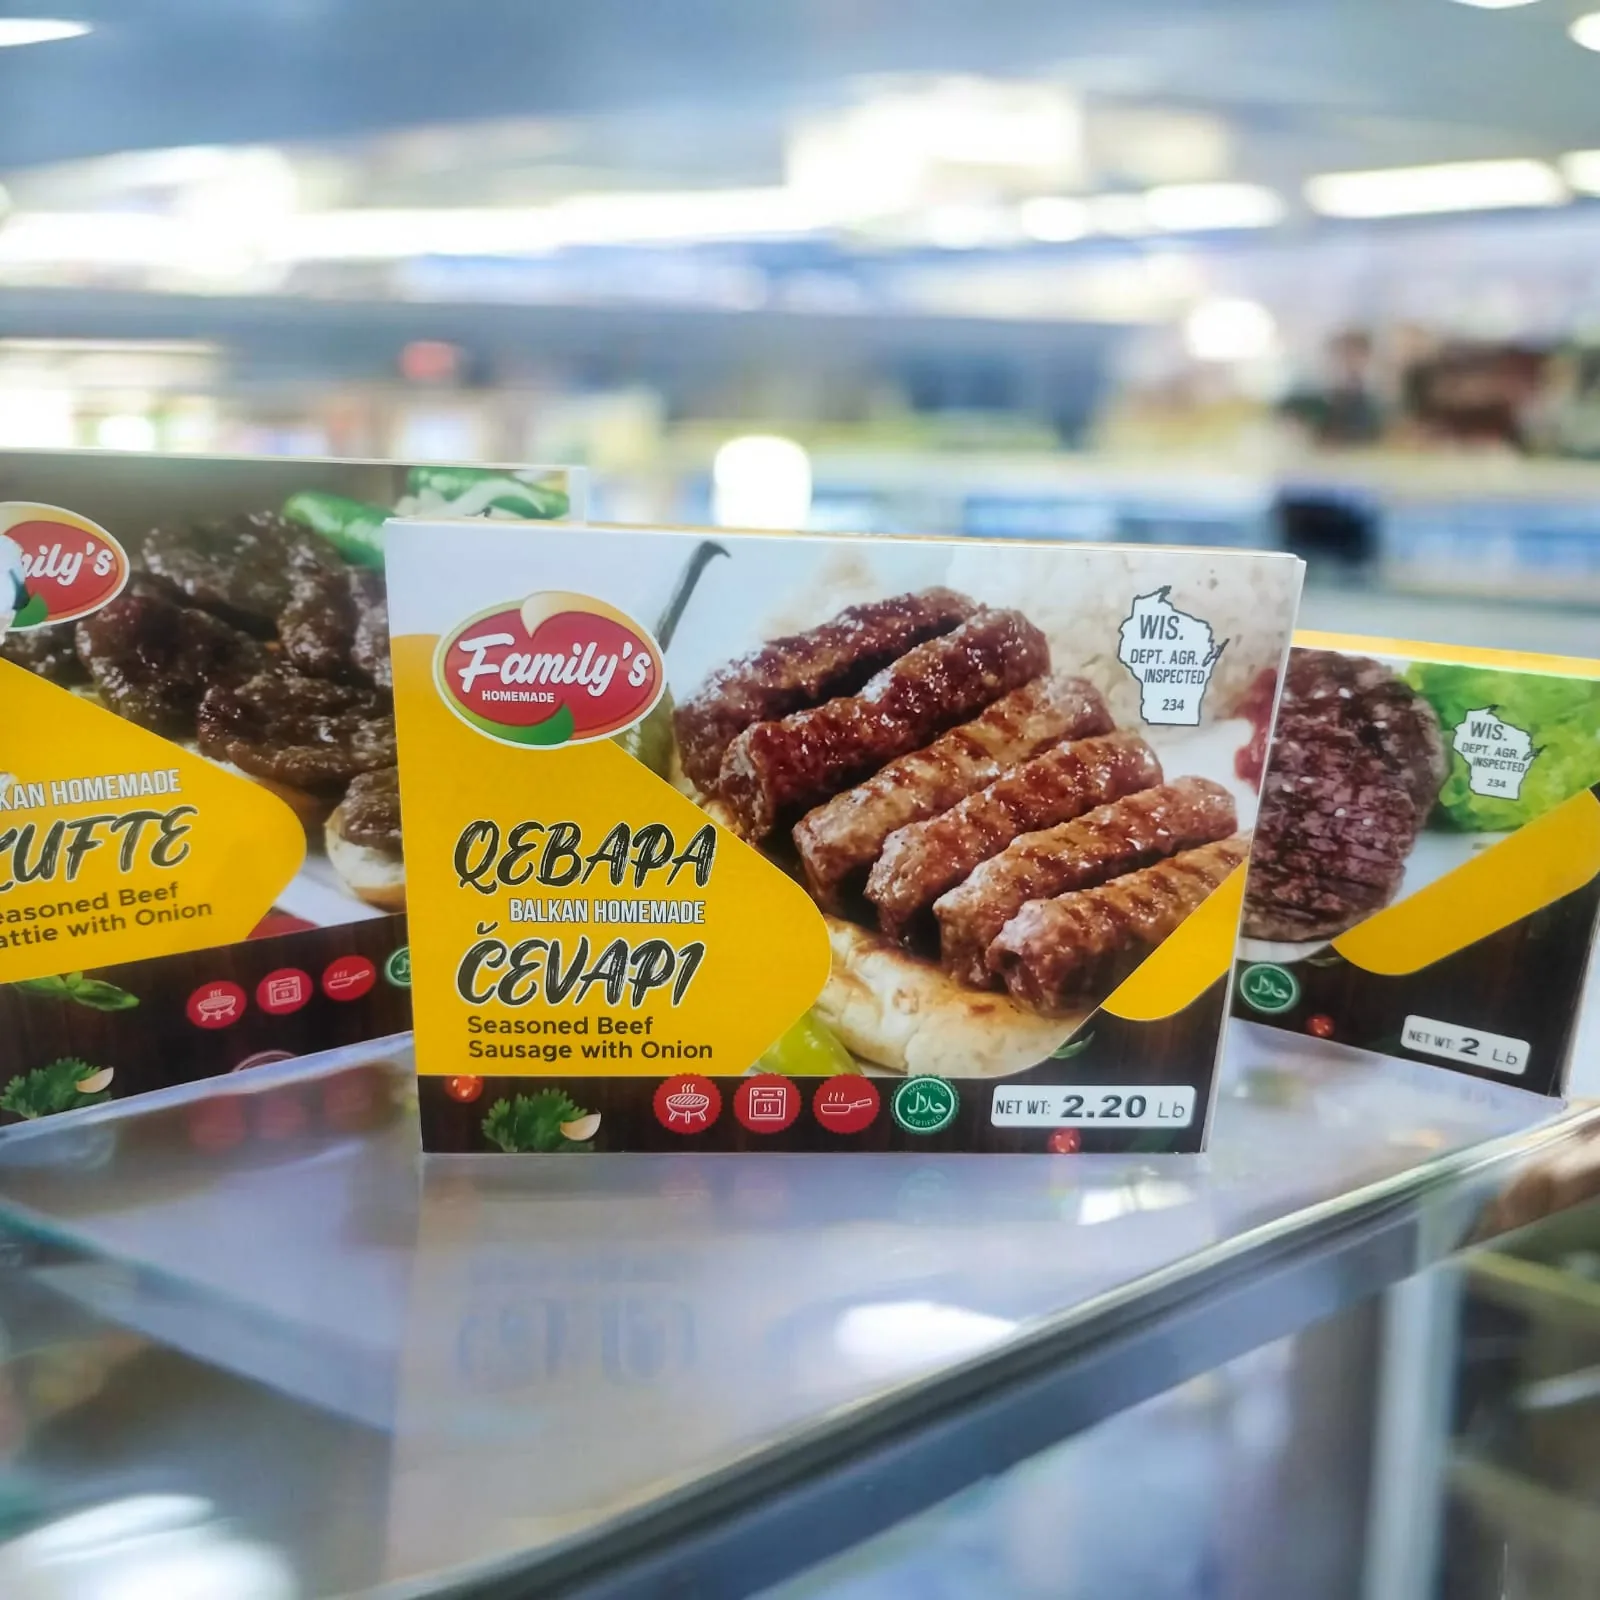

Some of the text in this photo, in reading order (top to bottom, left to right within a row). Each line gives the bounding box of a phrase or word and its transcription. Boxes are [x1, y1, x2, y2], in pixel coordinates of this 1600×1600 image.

[1139, 613, 1184, 641] WIS.
[458, 632, 652, 697] Family's
[1129, 648, 1199, 666] DEPT. AGR.
[1143, 668, 1206, 685] INSPECTED
[482, 689, 555, 704] HOMEMADE
[1161, 698, 1185, 711] 234
[1470, 720, 1508, 742] WIS.
[1461, 742, 1520, 760] DEPT. AGR.
[1472, 756, 1526, 773] INSPECTED
[50, 768, 183, 806] HOMEMADE
[1486, 777, 1507, 788] 234
[453, 819, 718, 896] QEBAPA
[118, 881, 179, 907] Beef
[66, 913, 127, 939] with
[135, 902, 213, 927] Onion
[509, 898, 706, 925] BALKAN HOMEMADE
[456, 920, 706, 1009] ČEVAPI
[467, 1015, 654, 1036] Seasoned Beef
[468, 1040, 714, 1062] Sausage with Onion
[1408, 1029, 1518, 1065] NET WT: 2 Lb
[906, 1091, 948, 1114] حلال
[995, 1094, 1186, 1119] NET WT: 2.20 Lb
